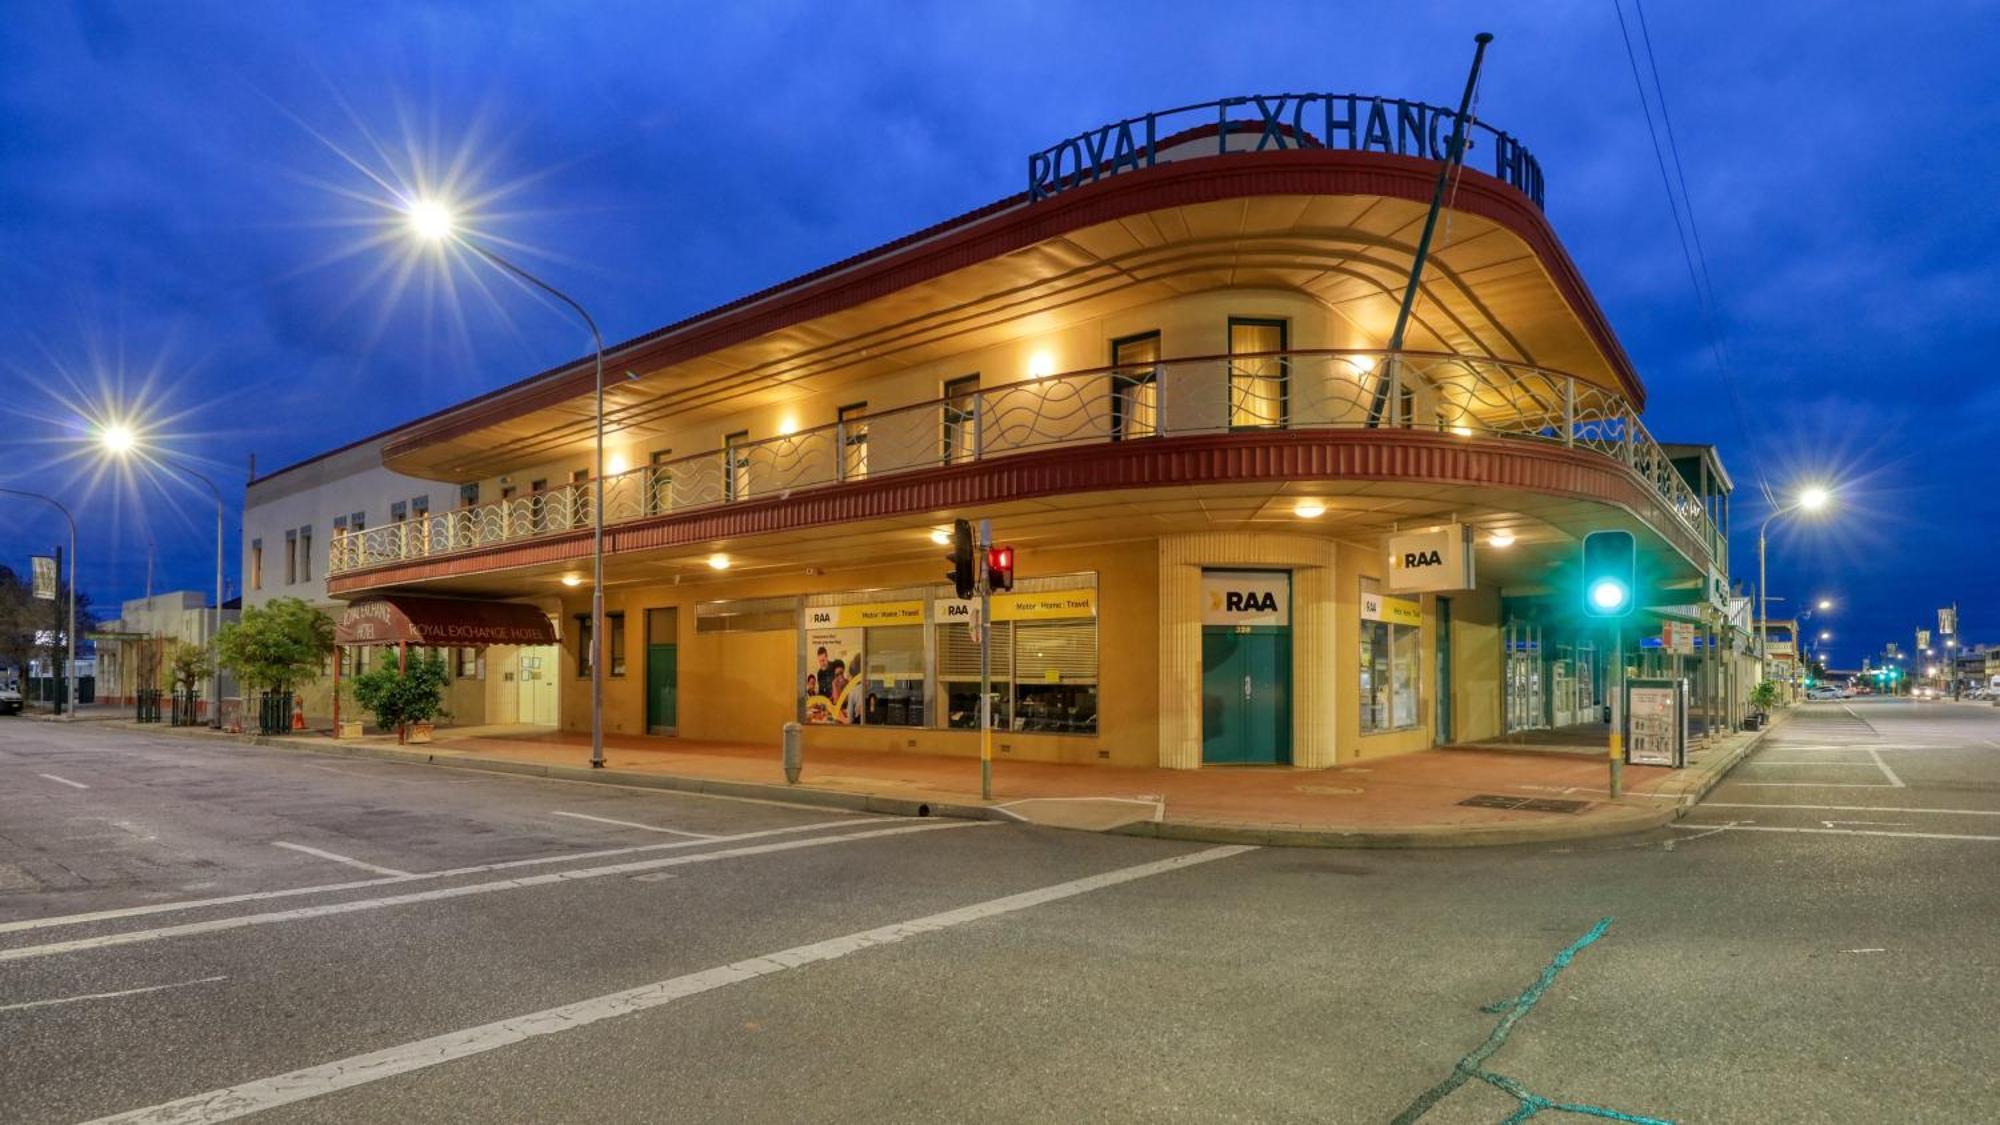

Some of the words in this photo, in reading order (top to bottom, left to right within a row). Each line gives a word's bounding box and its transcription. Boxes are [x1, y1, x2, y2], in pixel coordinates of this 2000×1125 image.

[1028, 112, 1172, 204] ROYAL
[1405, 551, 1442, 569] RAA
[948, 605, 969, 616] RAA
[1016, 602, 1037, 611] Motor
[1066, 599, 1089, 608] Travel
[1226, 592, 1278, 612] RAA
[814, 613, 831, 623] RAA
[409, 623, 448, 637] ROYAL
[448, 625, 509, 640] EXCHANGE
[510, 628, 544, 640] HOTEL
